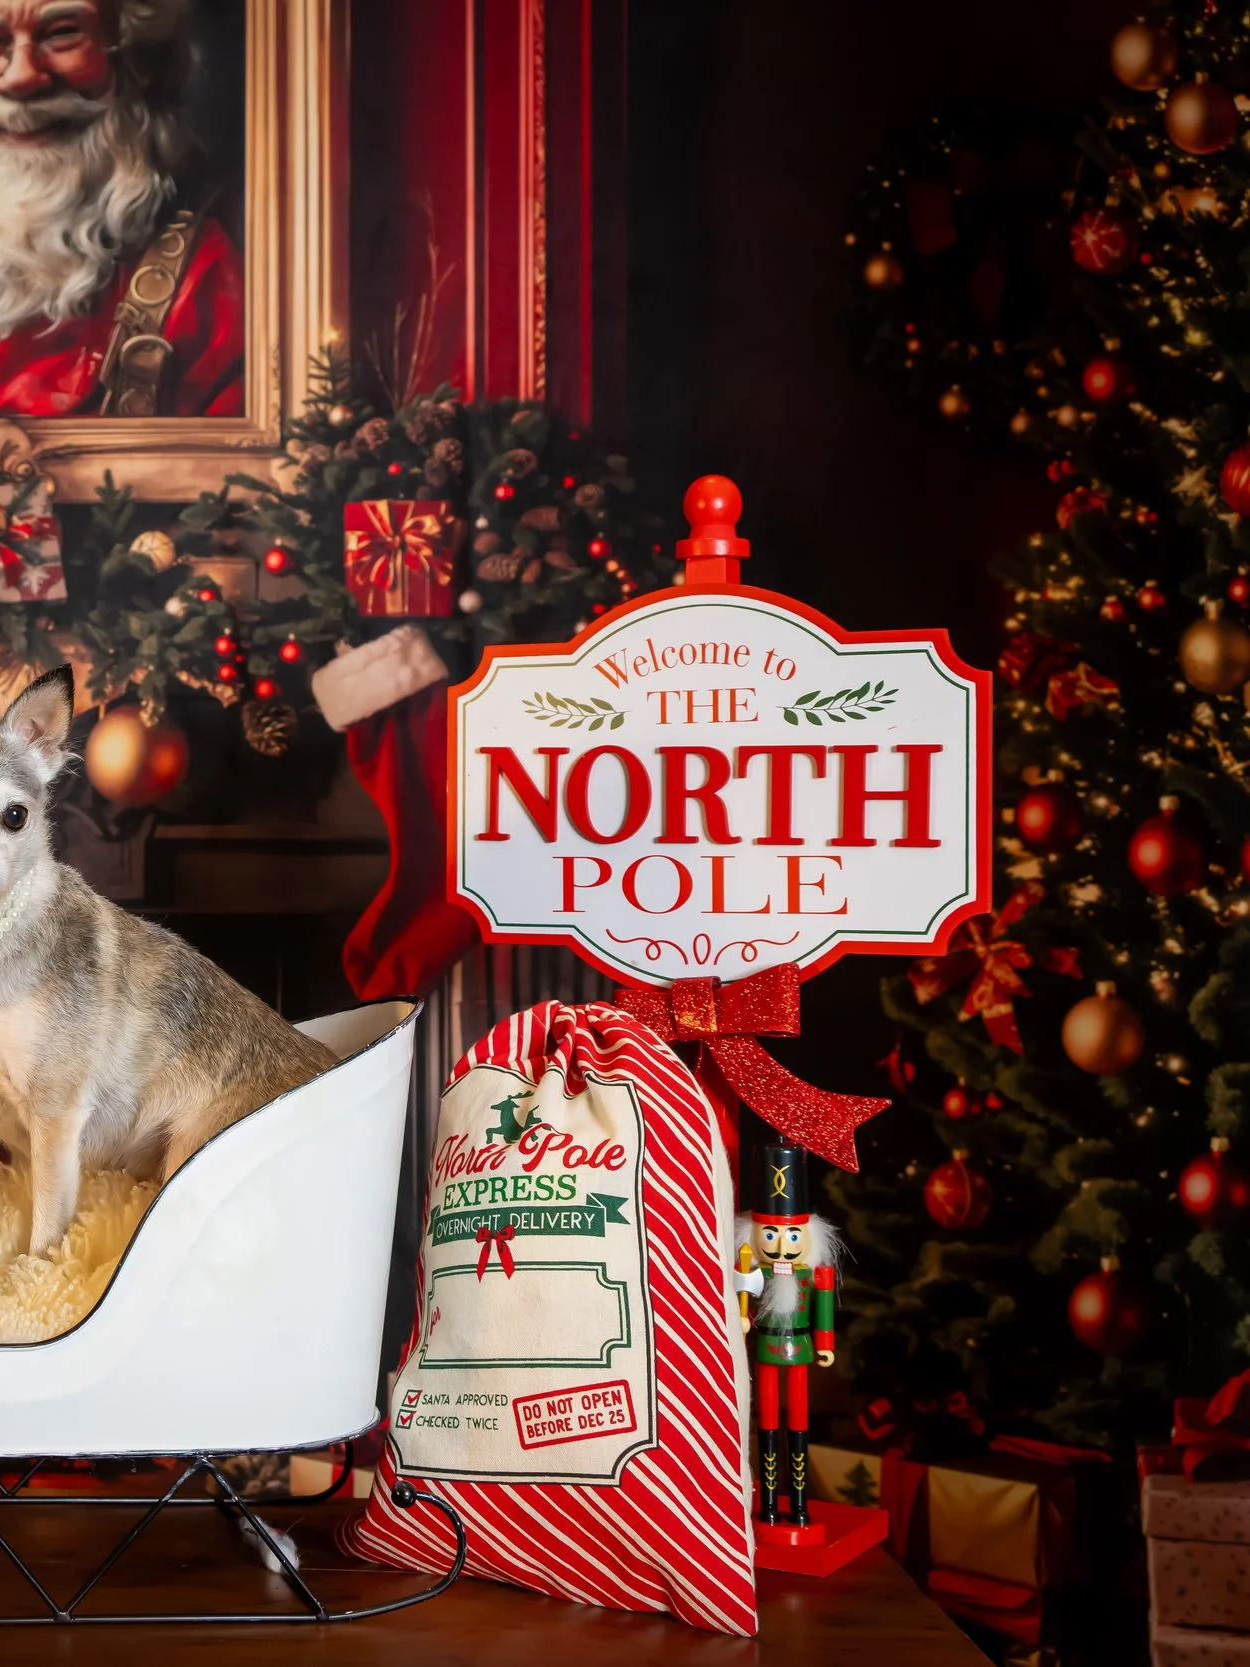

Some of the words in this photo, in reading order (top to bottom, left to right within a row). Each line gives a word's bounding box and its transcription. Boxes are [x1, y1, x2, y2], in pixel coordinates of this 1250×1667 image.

[591, 638, 750, 690] Welcome
[763, 647, 797, 681] to
[647, 688, 758, 725] THE
[475, 744, 943, 848] NORTH
[553, 855, 848, 915] POLE
[435, 1133, 511, 1188] North
[518, 1122, 627, 1172] Pole
[443, 1174, 577, 1211] EXPRESS
[436, 1214, 500, 1239] OVERNIGHT
[510, 1212, 596, 1230] DELIVERY
[421, 1394, 450, 1405] SANTA
[455, 1393, 508, 1407] APPROVED
[522, 1404, 542, 1421] DO
[547, 1397, 574, 1417] NOT
[581, 1389, 623, 1411] OPEN
[416, 1416, 460, 1429] CHECKED
[466, 1417, 498, 1430] TWICE
[526, 1418, 573, 1439] BEFORE
[578, 1413, 605, 1430] DEC
[609, 1409, 626, 1425] 25
